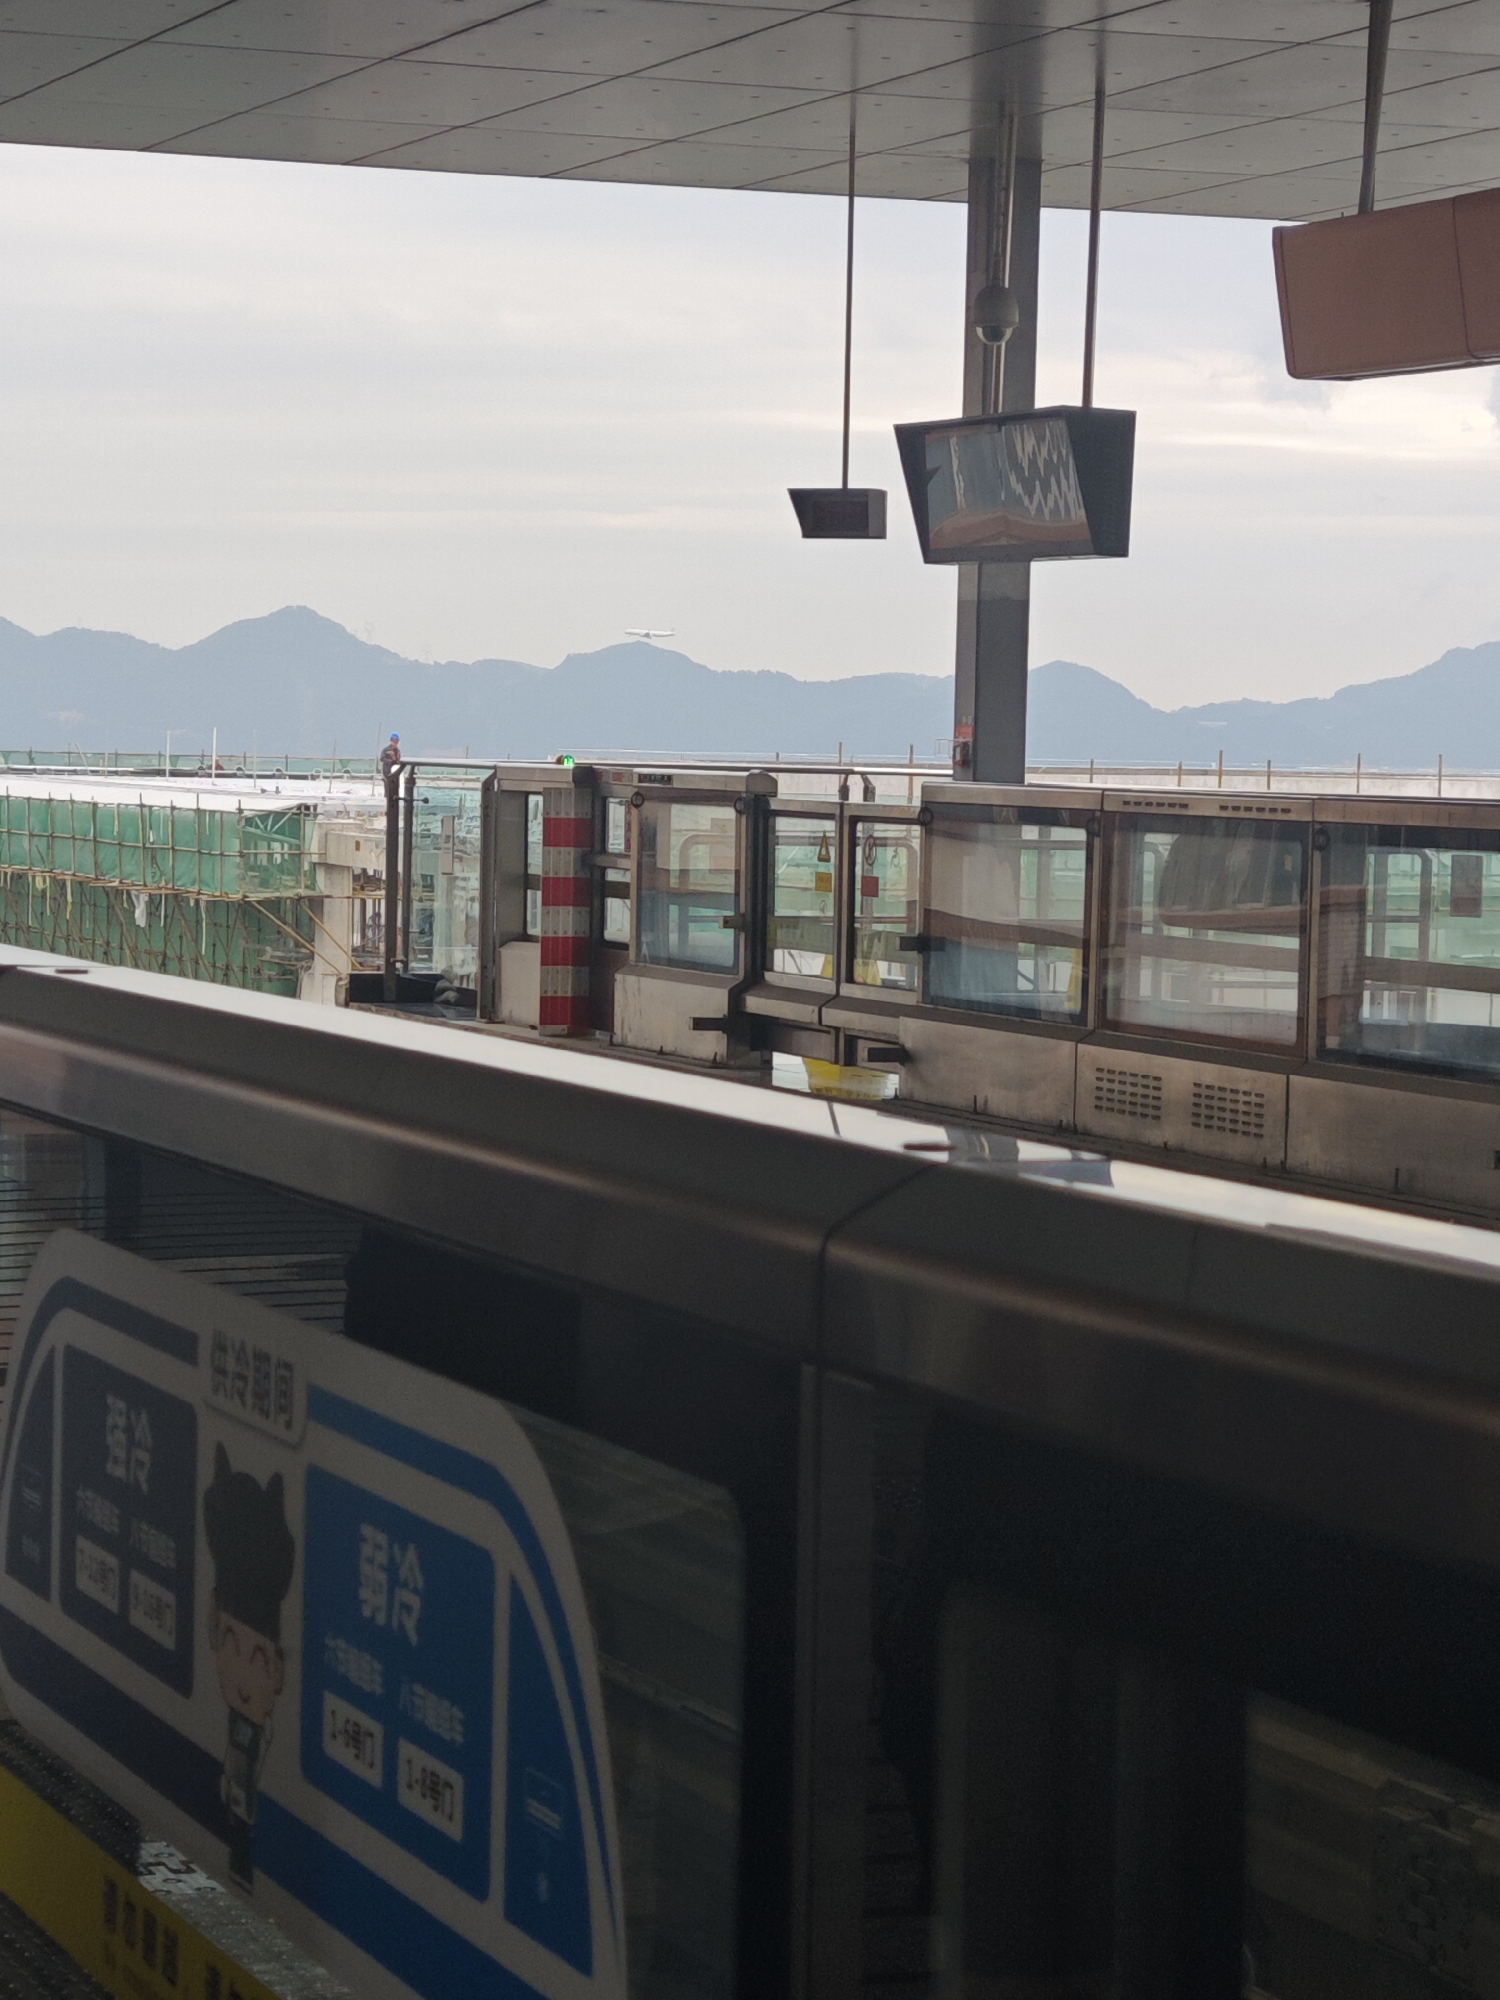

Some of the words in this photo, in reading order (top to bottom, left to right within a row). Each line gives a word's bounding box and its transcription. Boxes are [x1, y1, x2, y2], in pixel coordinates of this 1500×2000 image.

[211, 1329, 294, 1431] 供冷期间
[106, 1393, 153, 1496] 强冷
[359, 1522, 425, 1647] 弱冷
[329, 1708, 376, 1771] 1-6号门
[405, 1756, 456, 1823] 1-8号门
